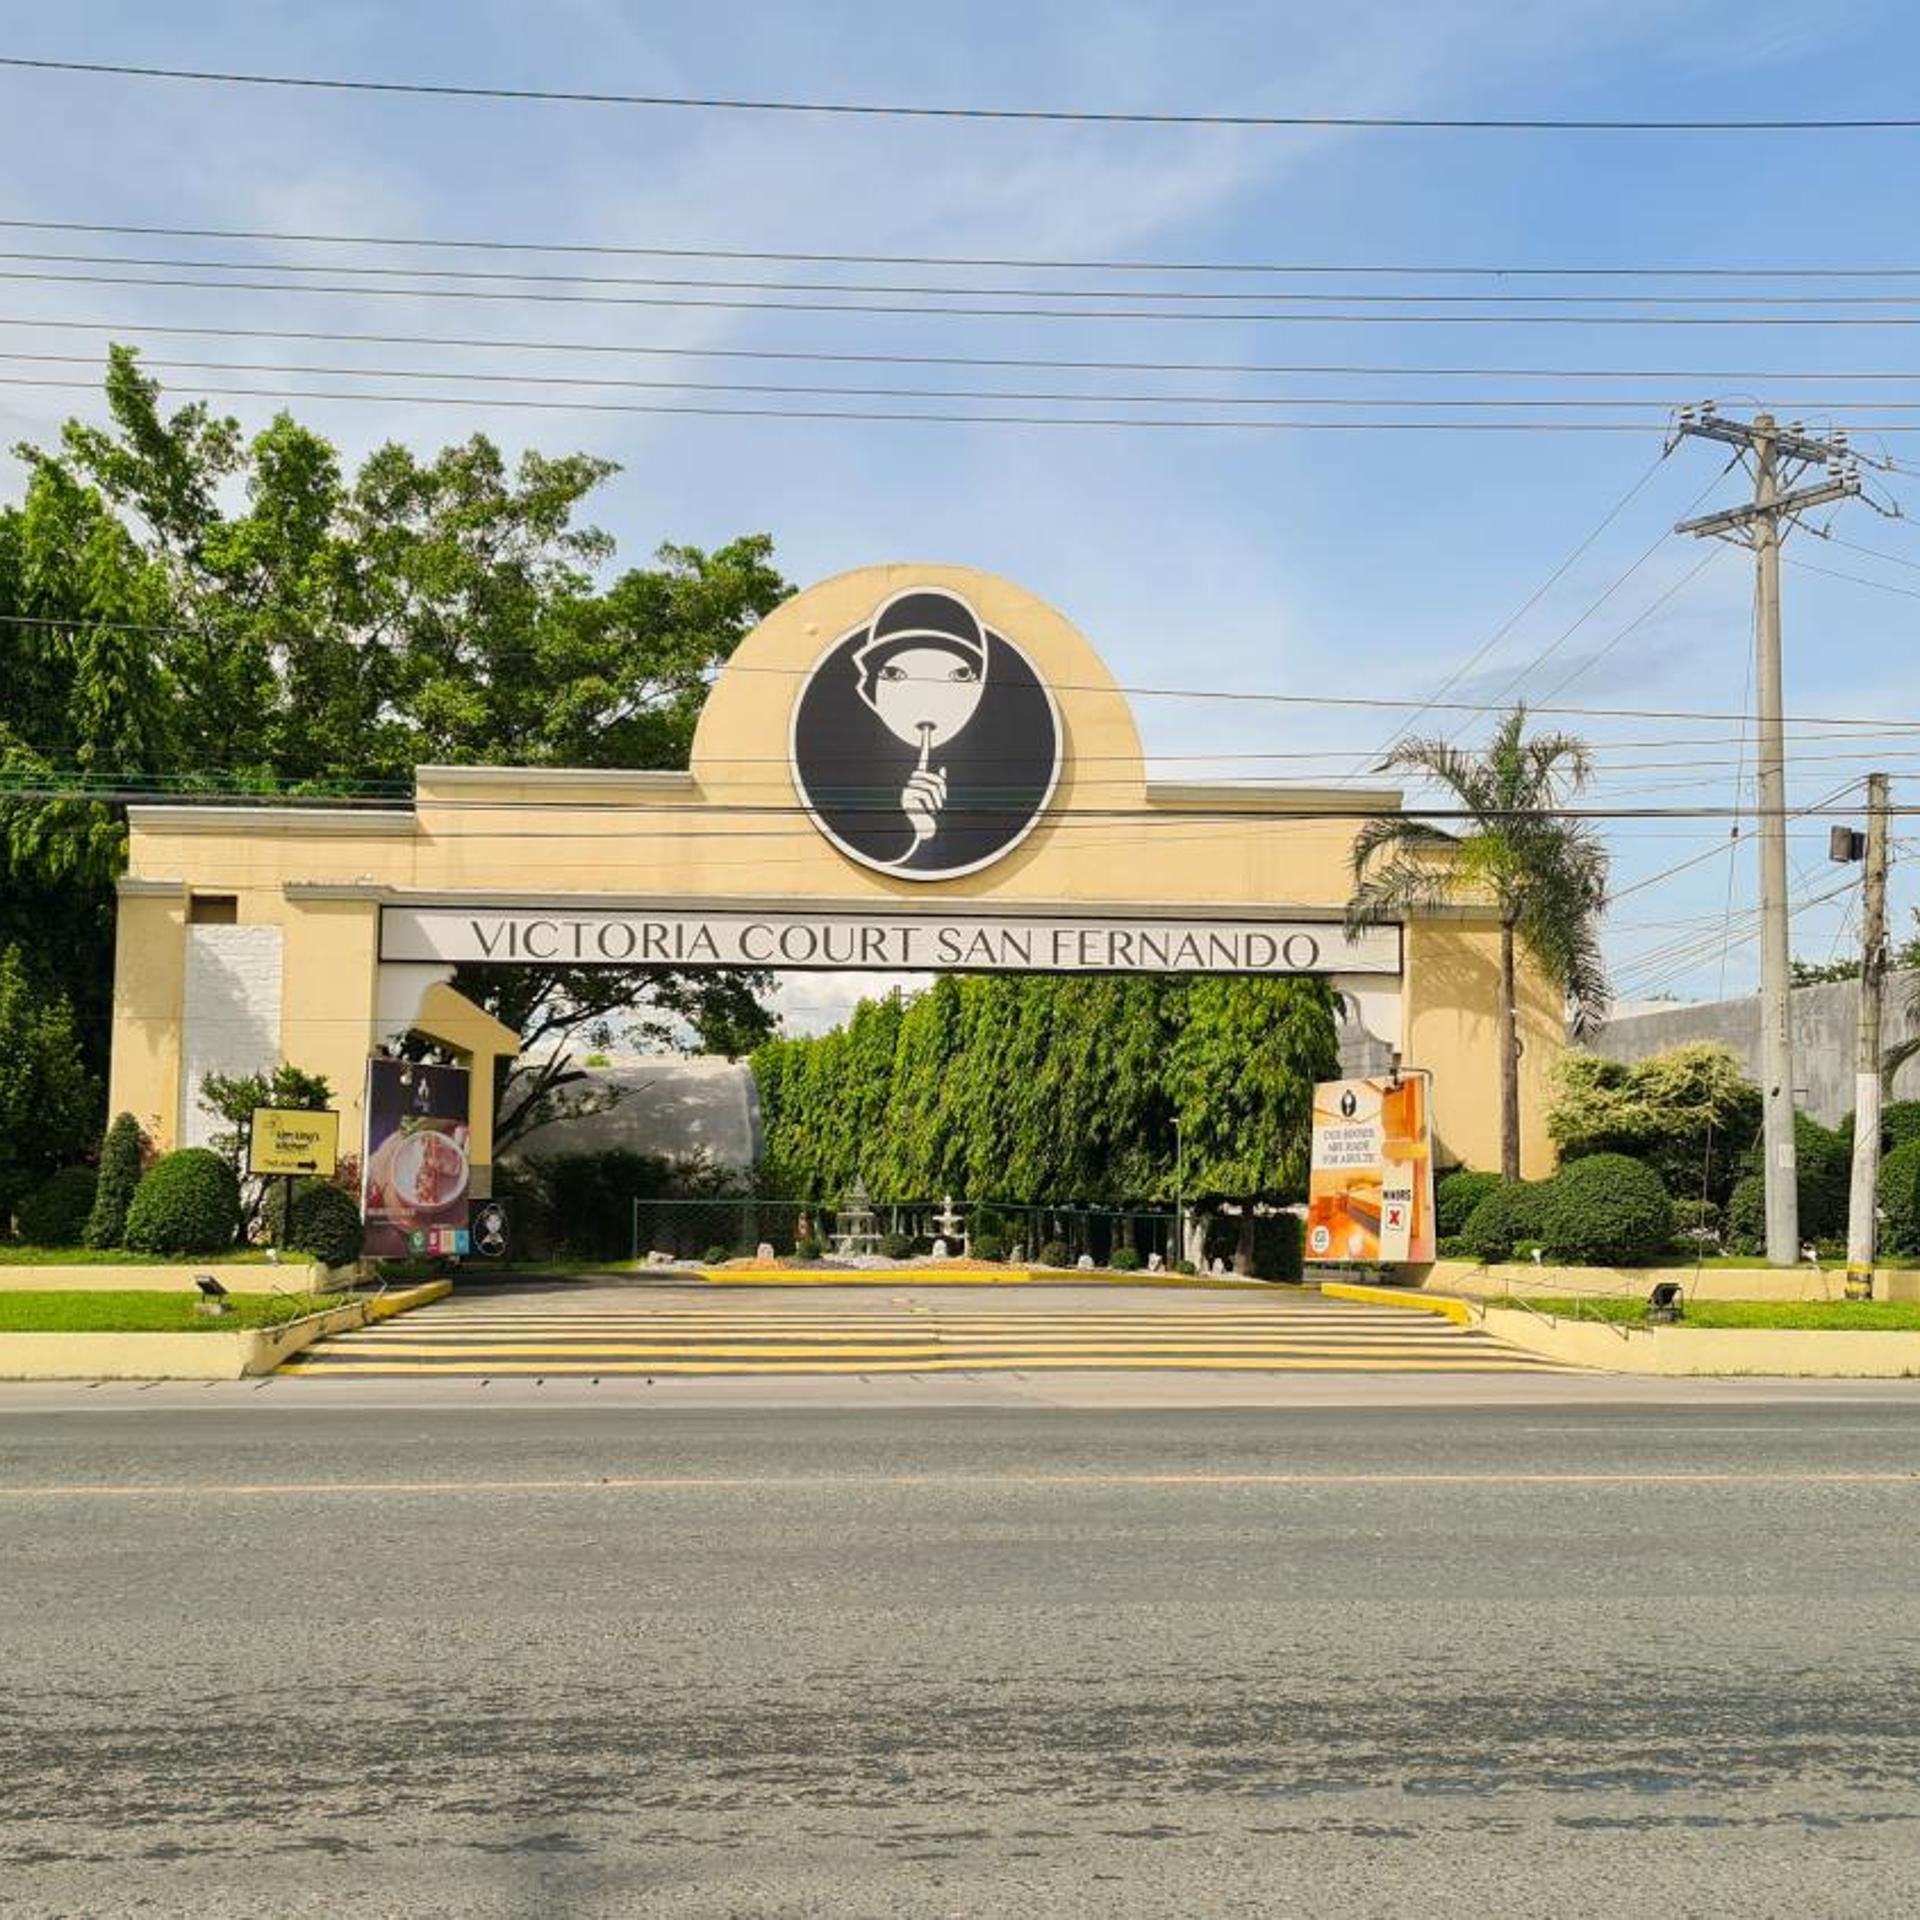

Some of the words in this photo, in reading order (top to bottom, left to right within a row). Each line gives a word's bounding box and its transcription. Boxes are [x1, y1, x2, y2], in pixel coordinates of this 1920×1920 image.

[470, 920, 721, 959] VICTORIA
[738, 924, 922, 962] COURT
[937, 926, 1032, 964] SAN
[1052, 929, 1320, 969] FERNANDO
[1383, 1189, 1411, 1202] MINORS
